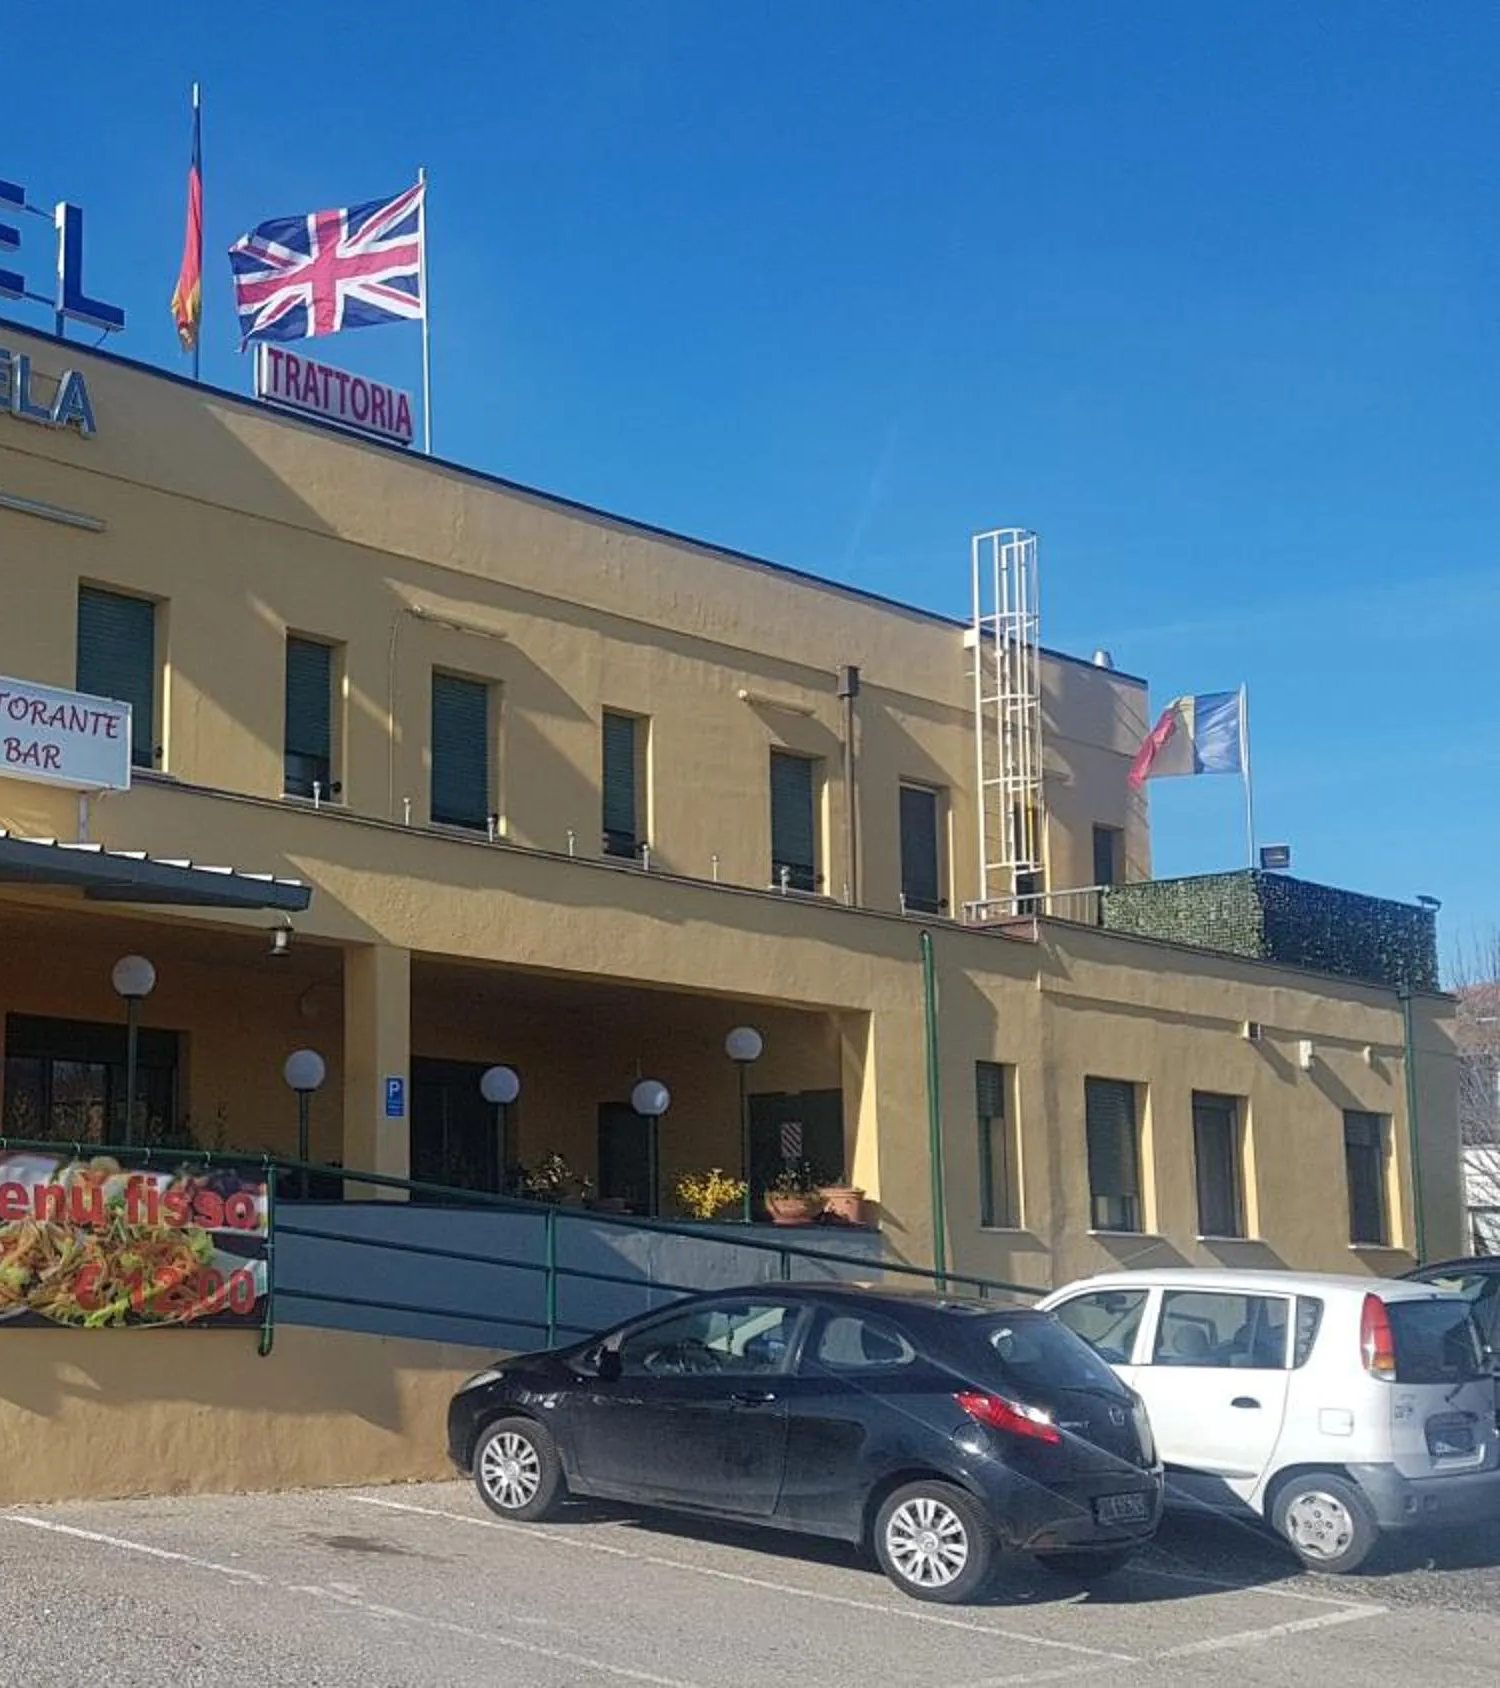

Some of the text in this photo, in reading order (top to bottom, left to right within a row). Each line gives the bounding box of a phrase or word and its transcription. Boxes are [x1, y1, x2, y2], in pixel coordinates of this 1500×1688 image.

[267, 347, 413, 437] TRATTORIA
[3, 737, 62, 770] BAR
[124, 1174, 259, 1230] fisso
